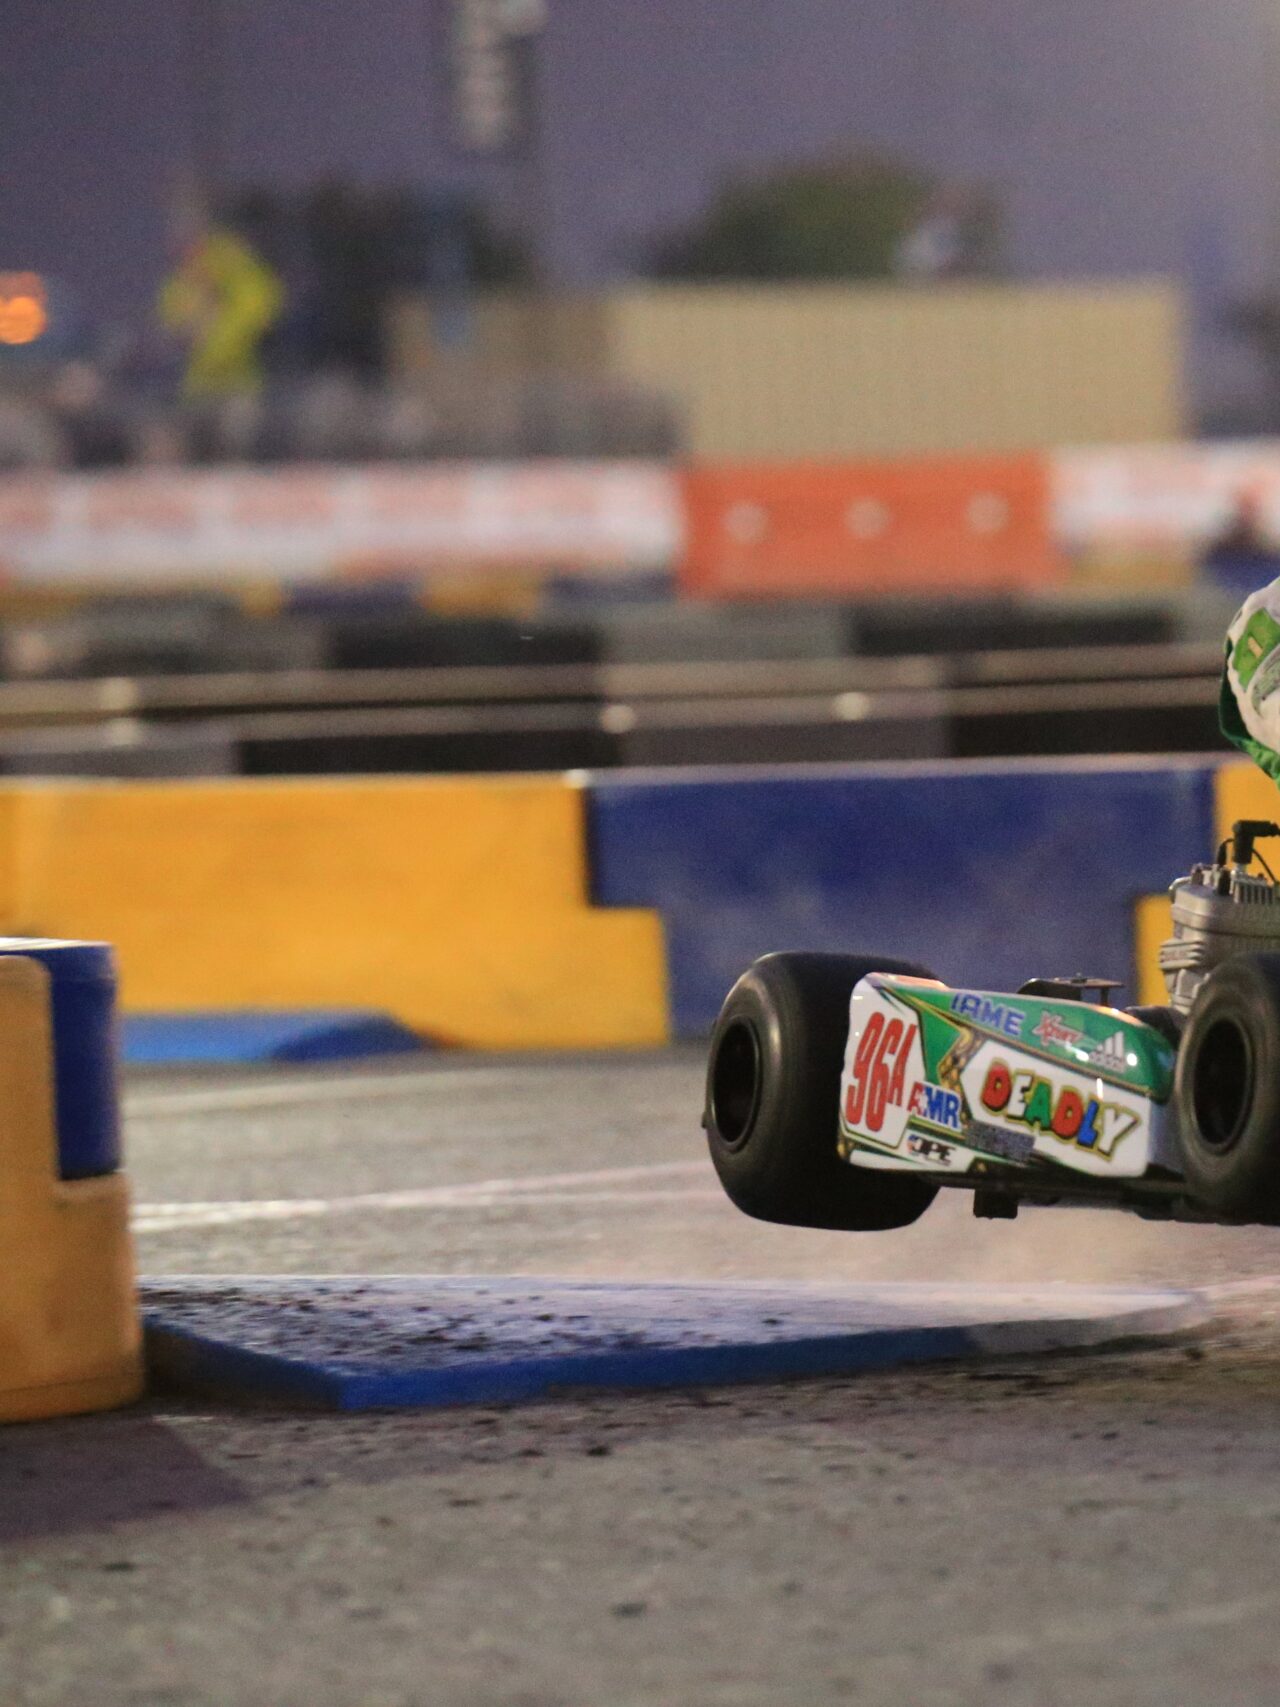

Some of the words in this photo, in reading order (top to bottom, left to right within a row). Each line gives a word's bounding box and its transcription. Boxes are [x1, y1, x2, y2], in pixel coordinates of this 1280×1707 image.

[951, 993, 1025, 1036] IAME
[845, 1011, 917, 1132] 96A
[906, 1081, 961, 1129] AMR
[980, 1059, 1139, 1159] DEADLY
